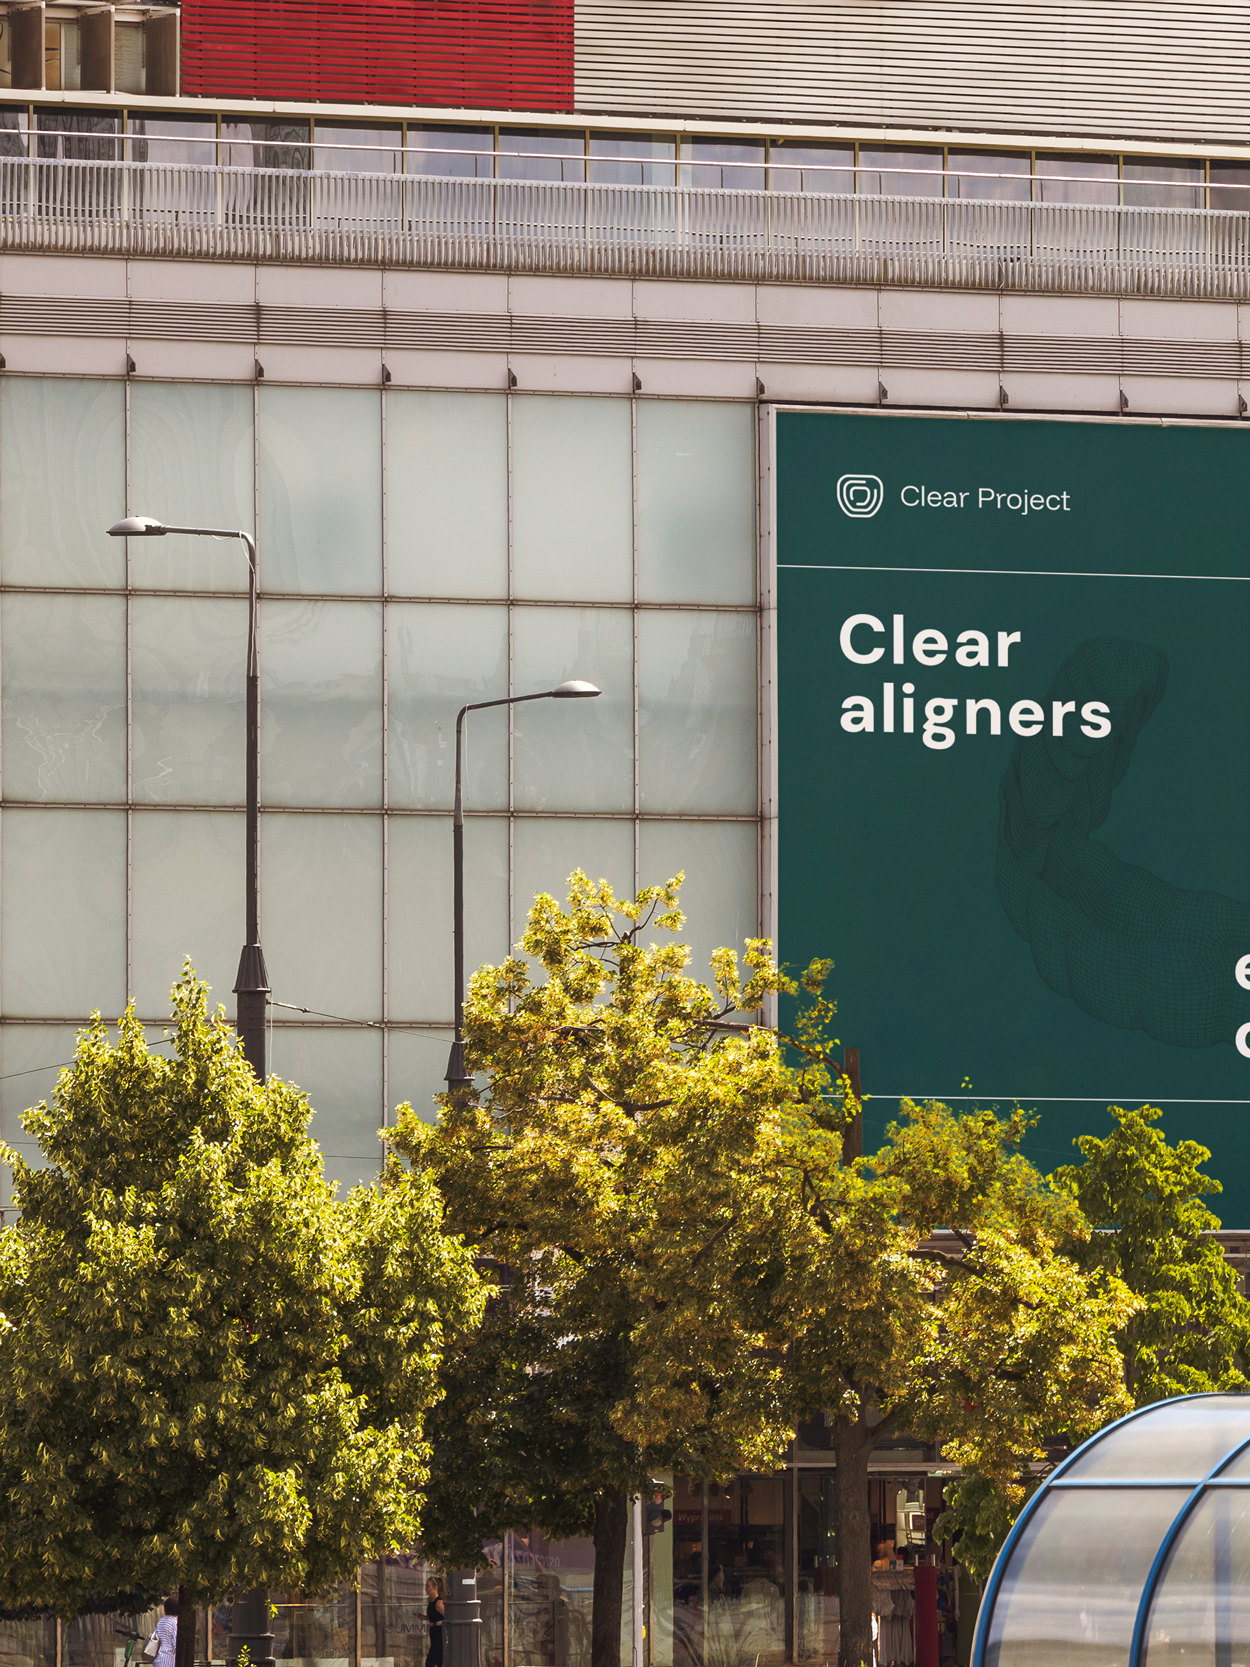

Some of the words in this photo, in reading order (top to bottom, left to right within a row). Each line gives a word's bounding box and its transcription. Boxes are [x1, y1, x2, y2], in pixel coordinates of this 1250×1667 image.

[901, 485, 970, 508] Clear
[979, 487, 1071, 516] Project
[840, 613, 1022, 668] Clear
[840, 681, 1112, 751] aligners
